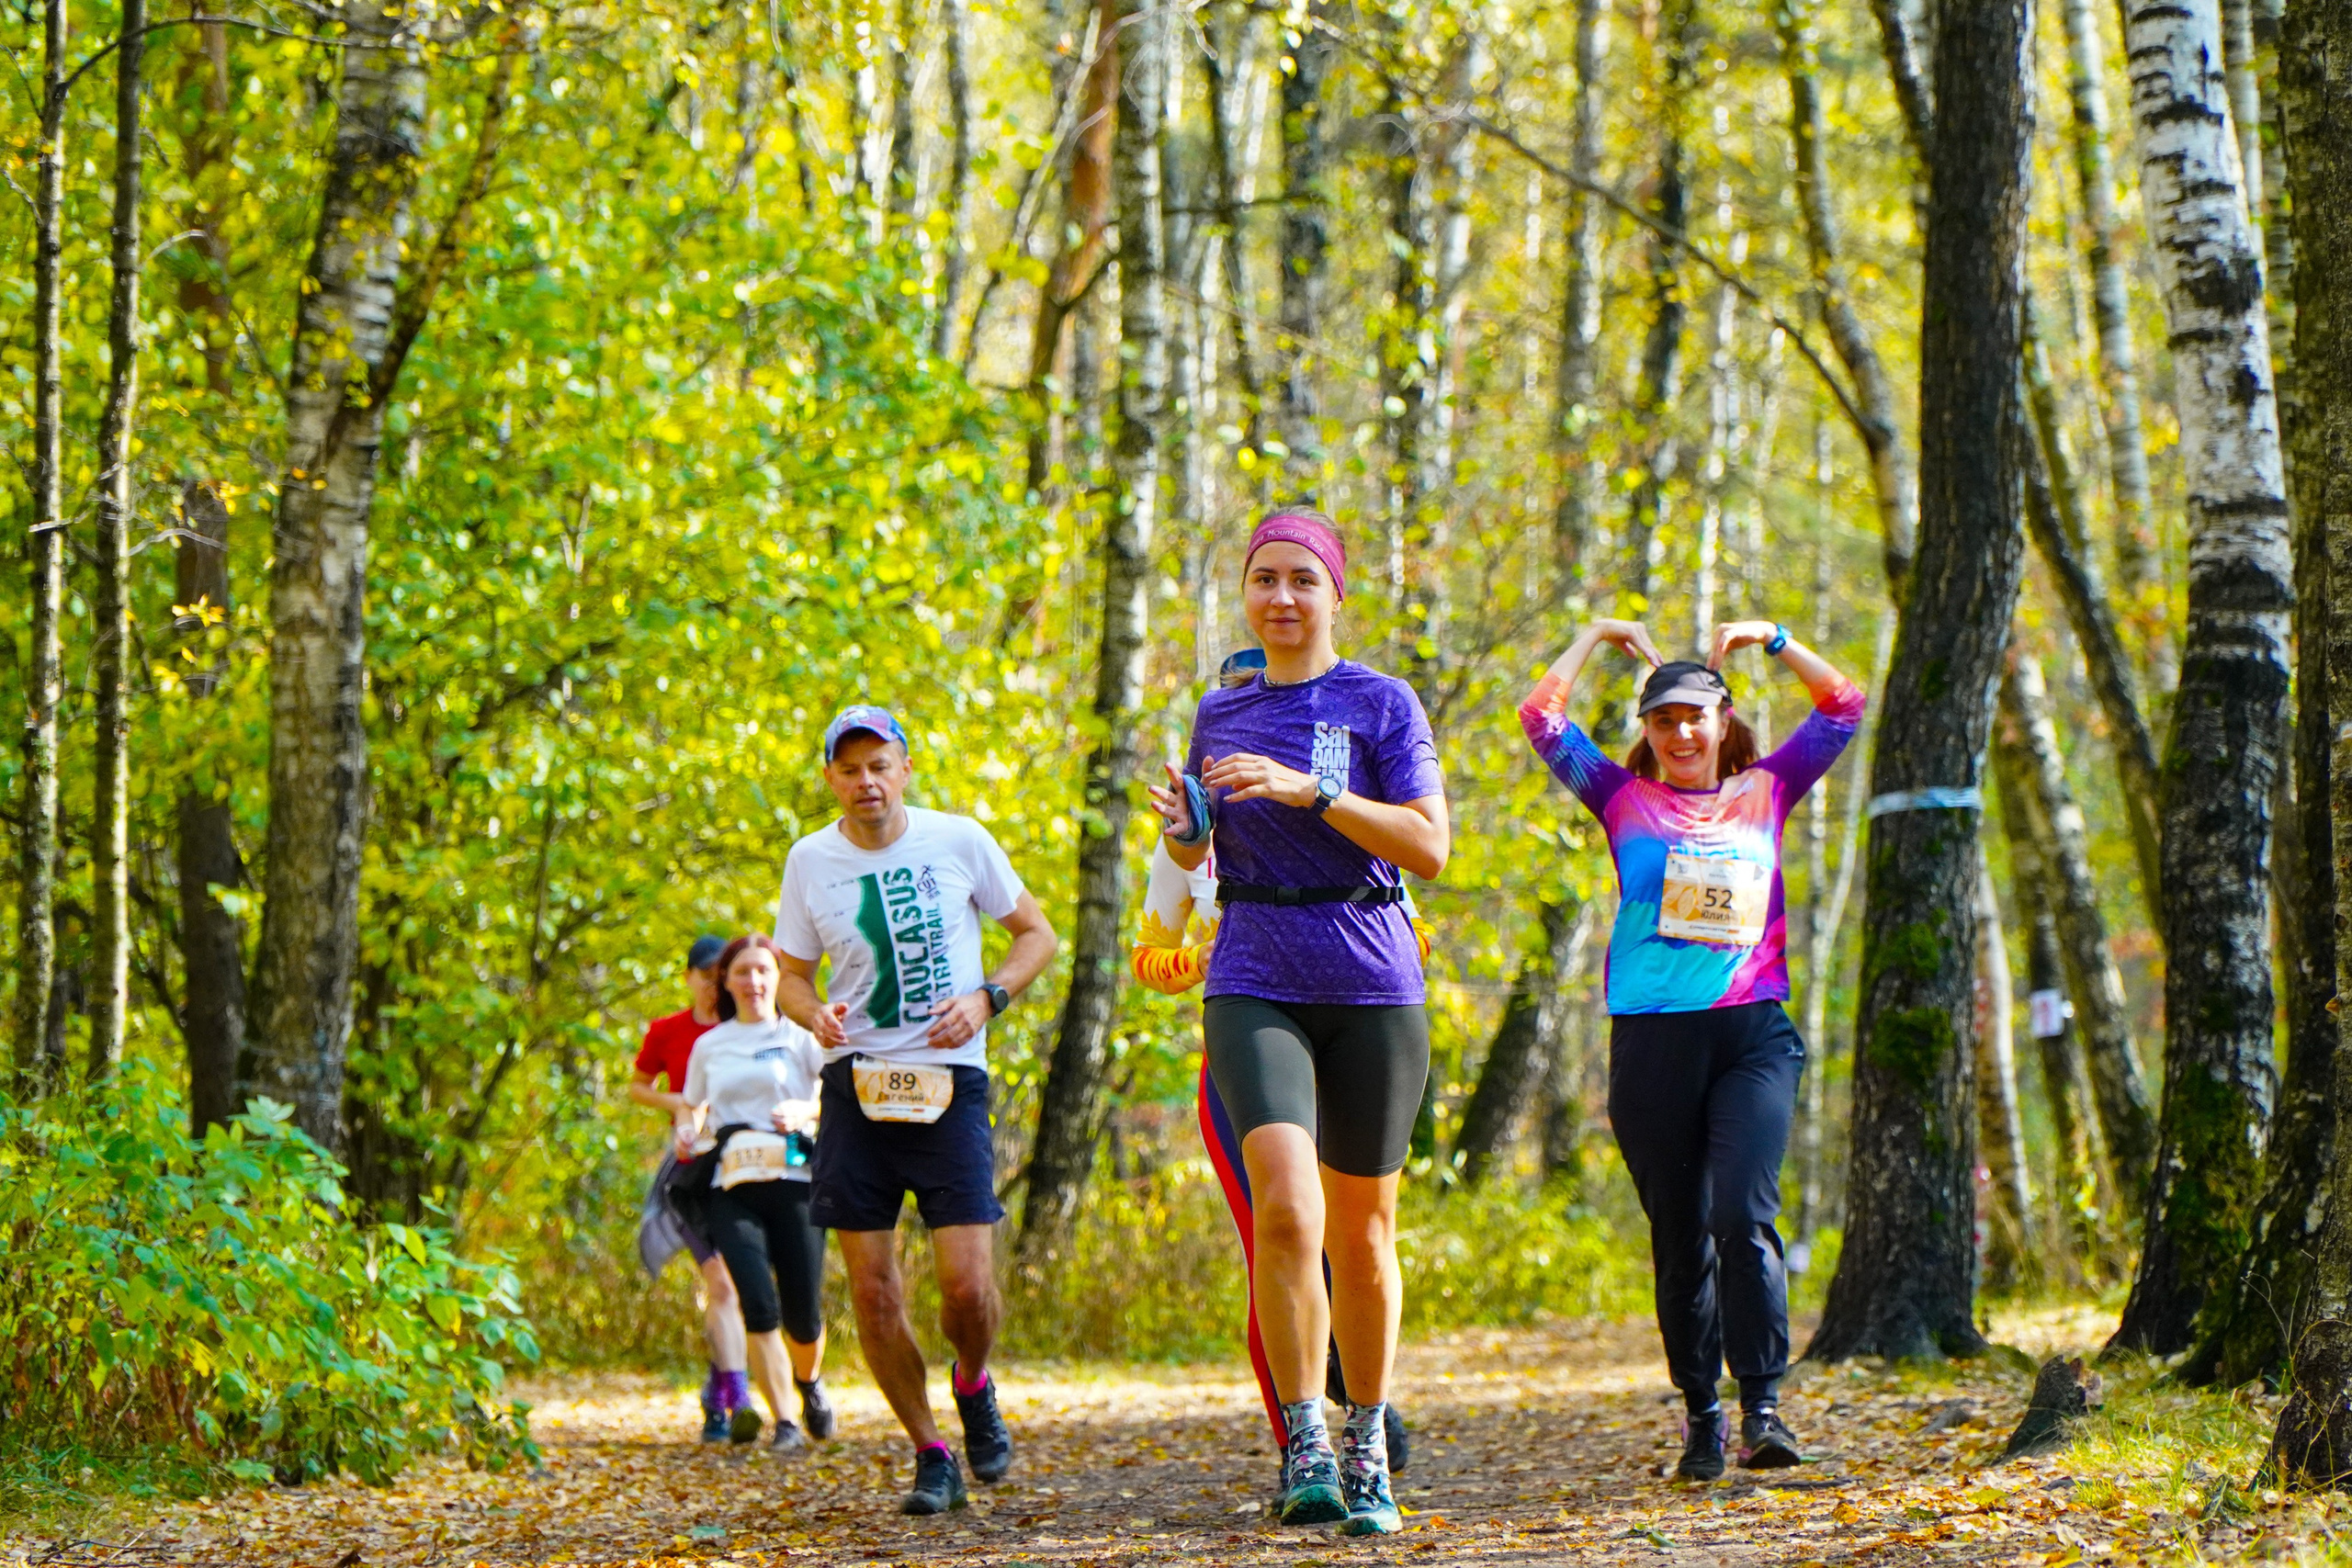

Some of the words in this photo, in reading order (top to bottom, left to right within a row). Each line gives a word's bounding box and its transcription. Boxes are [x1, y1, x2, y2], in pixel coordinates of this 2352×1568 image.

[1268, 530, 1306, 540] Mountain
[1309, 537, 1324, 554] Race
[1313, 721, 1351, 749] Sat
[1310, 748, 1351, 769] 9AM
[1703, 887, 1733, 908] 52
[883, 867, 933, 1022] CAUCASUS
[888, 1072, 916, 1090] 89
